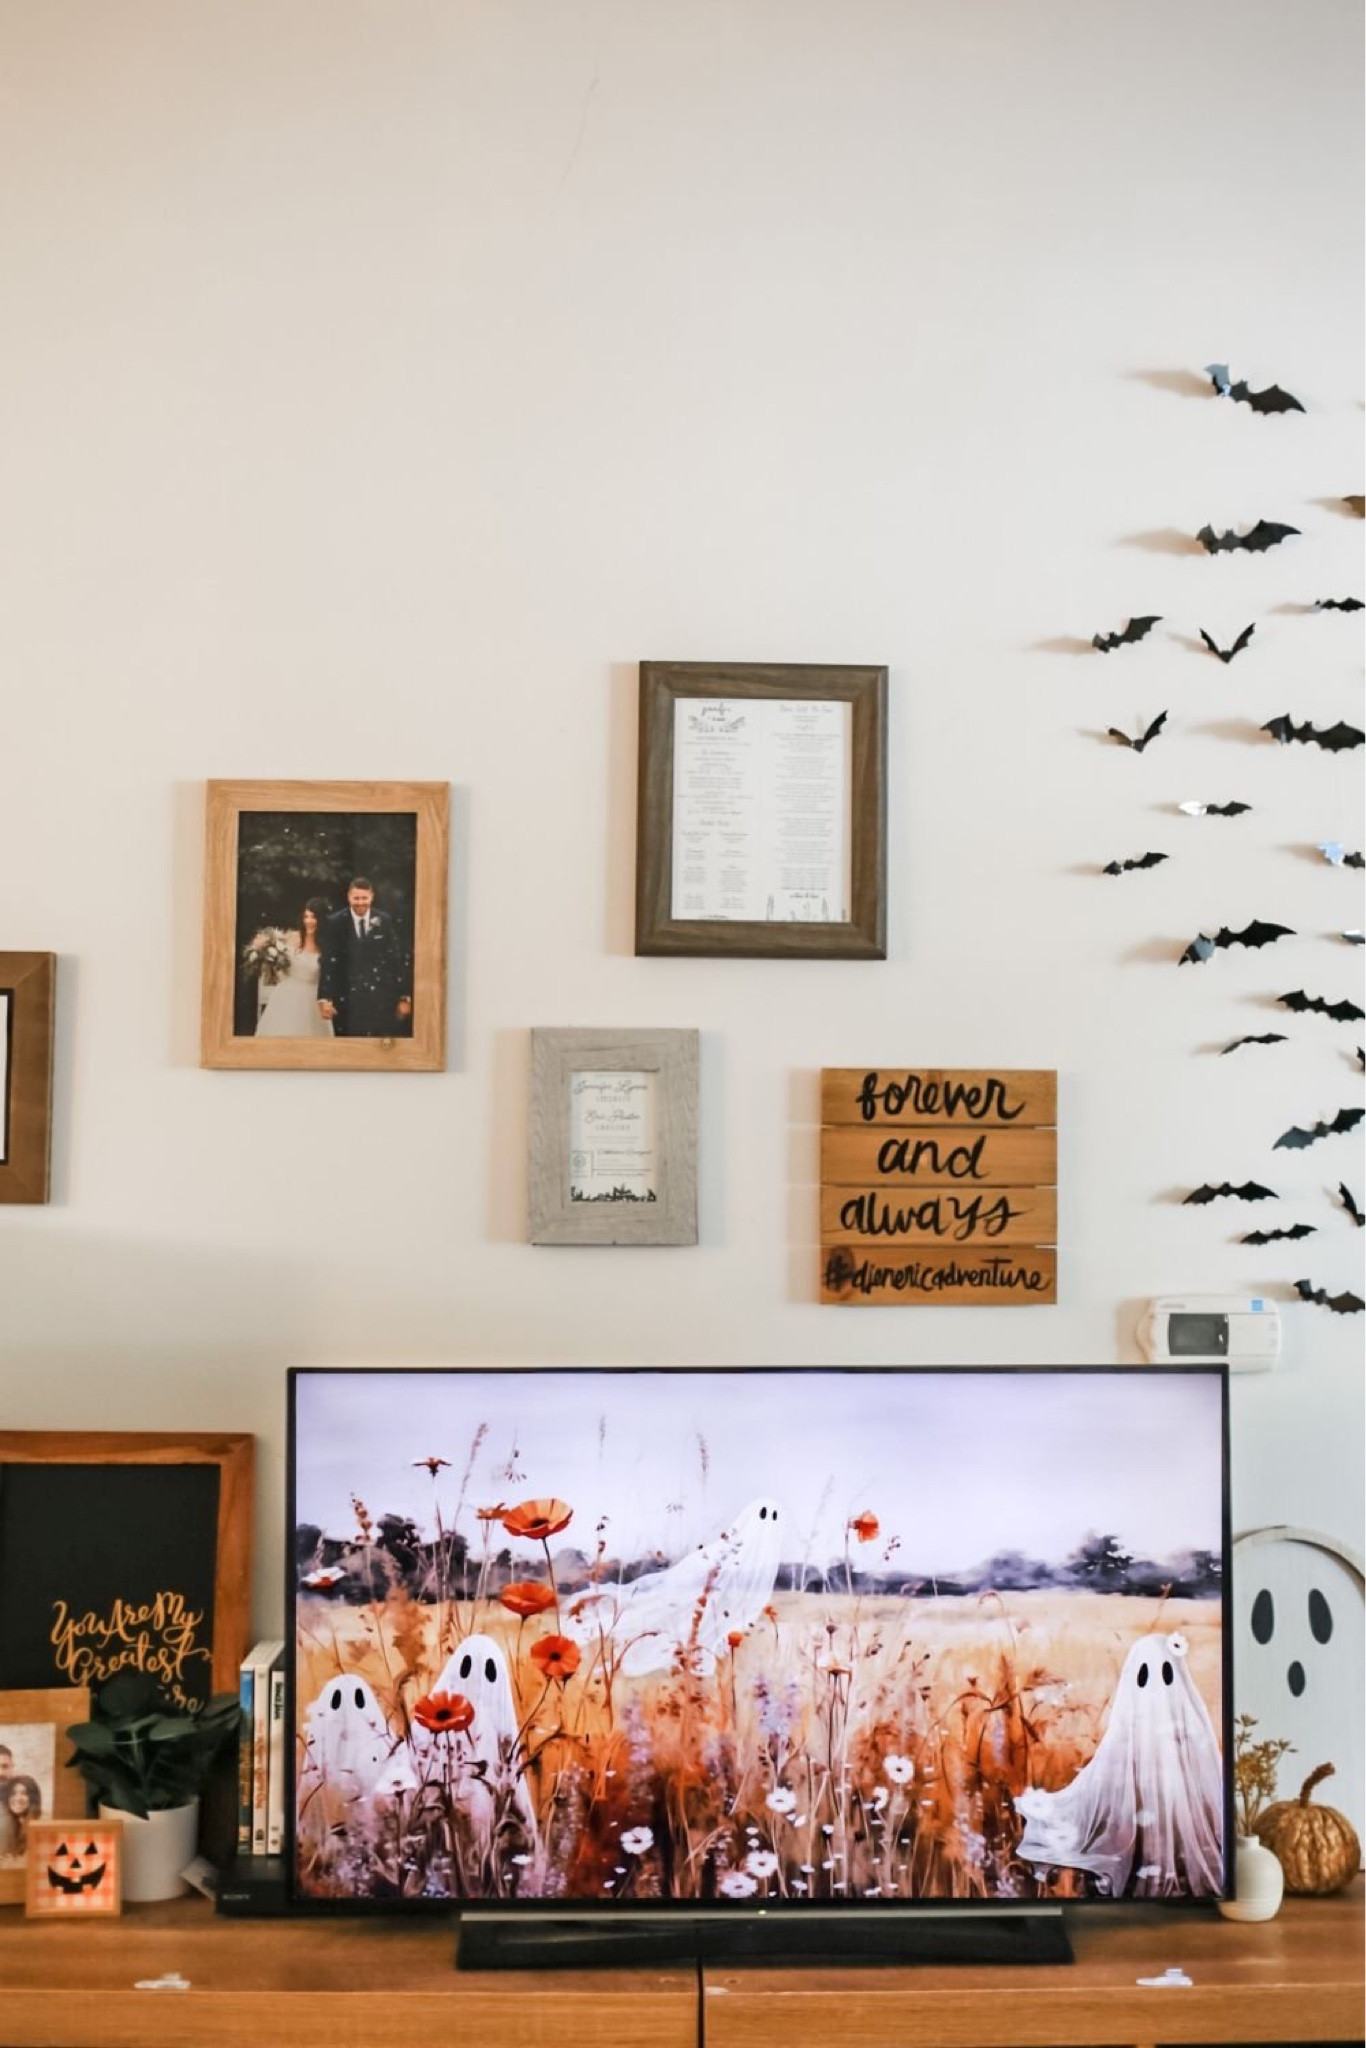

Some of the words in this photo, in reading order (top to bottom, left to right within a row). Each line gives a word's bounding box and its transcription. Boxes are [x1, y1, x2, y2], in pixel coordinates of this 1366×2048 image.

[855, 1072, 1026, 1121] forever
[877, 1135, 991, 1179] and
[840, 1192, 1035, 1241] always
[50, 1599, 107, 1670] You
[96, 1599, 154, 1649] Are
[153, 1591, 204, 1643] My
[69, 1630, 213, 1688] Greatest
